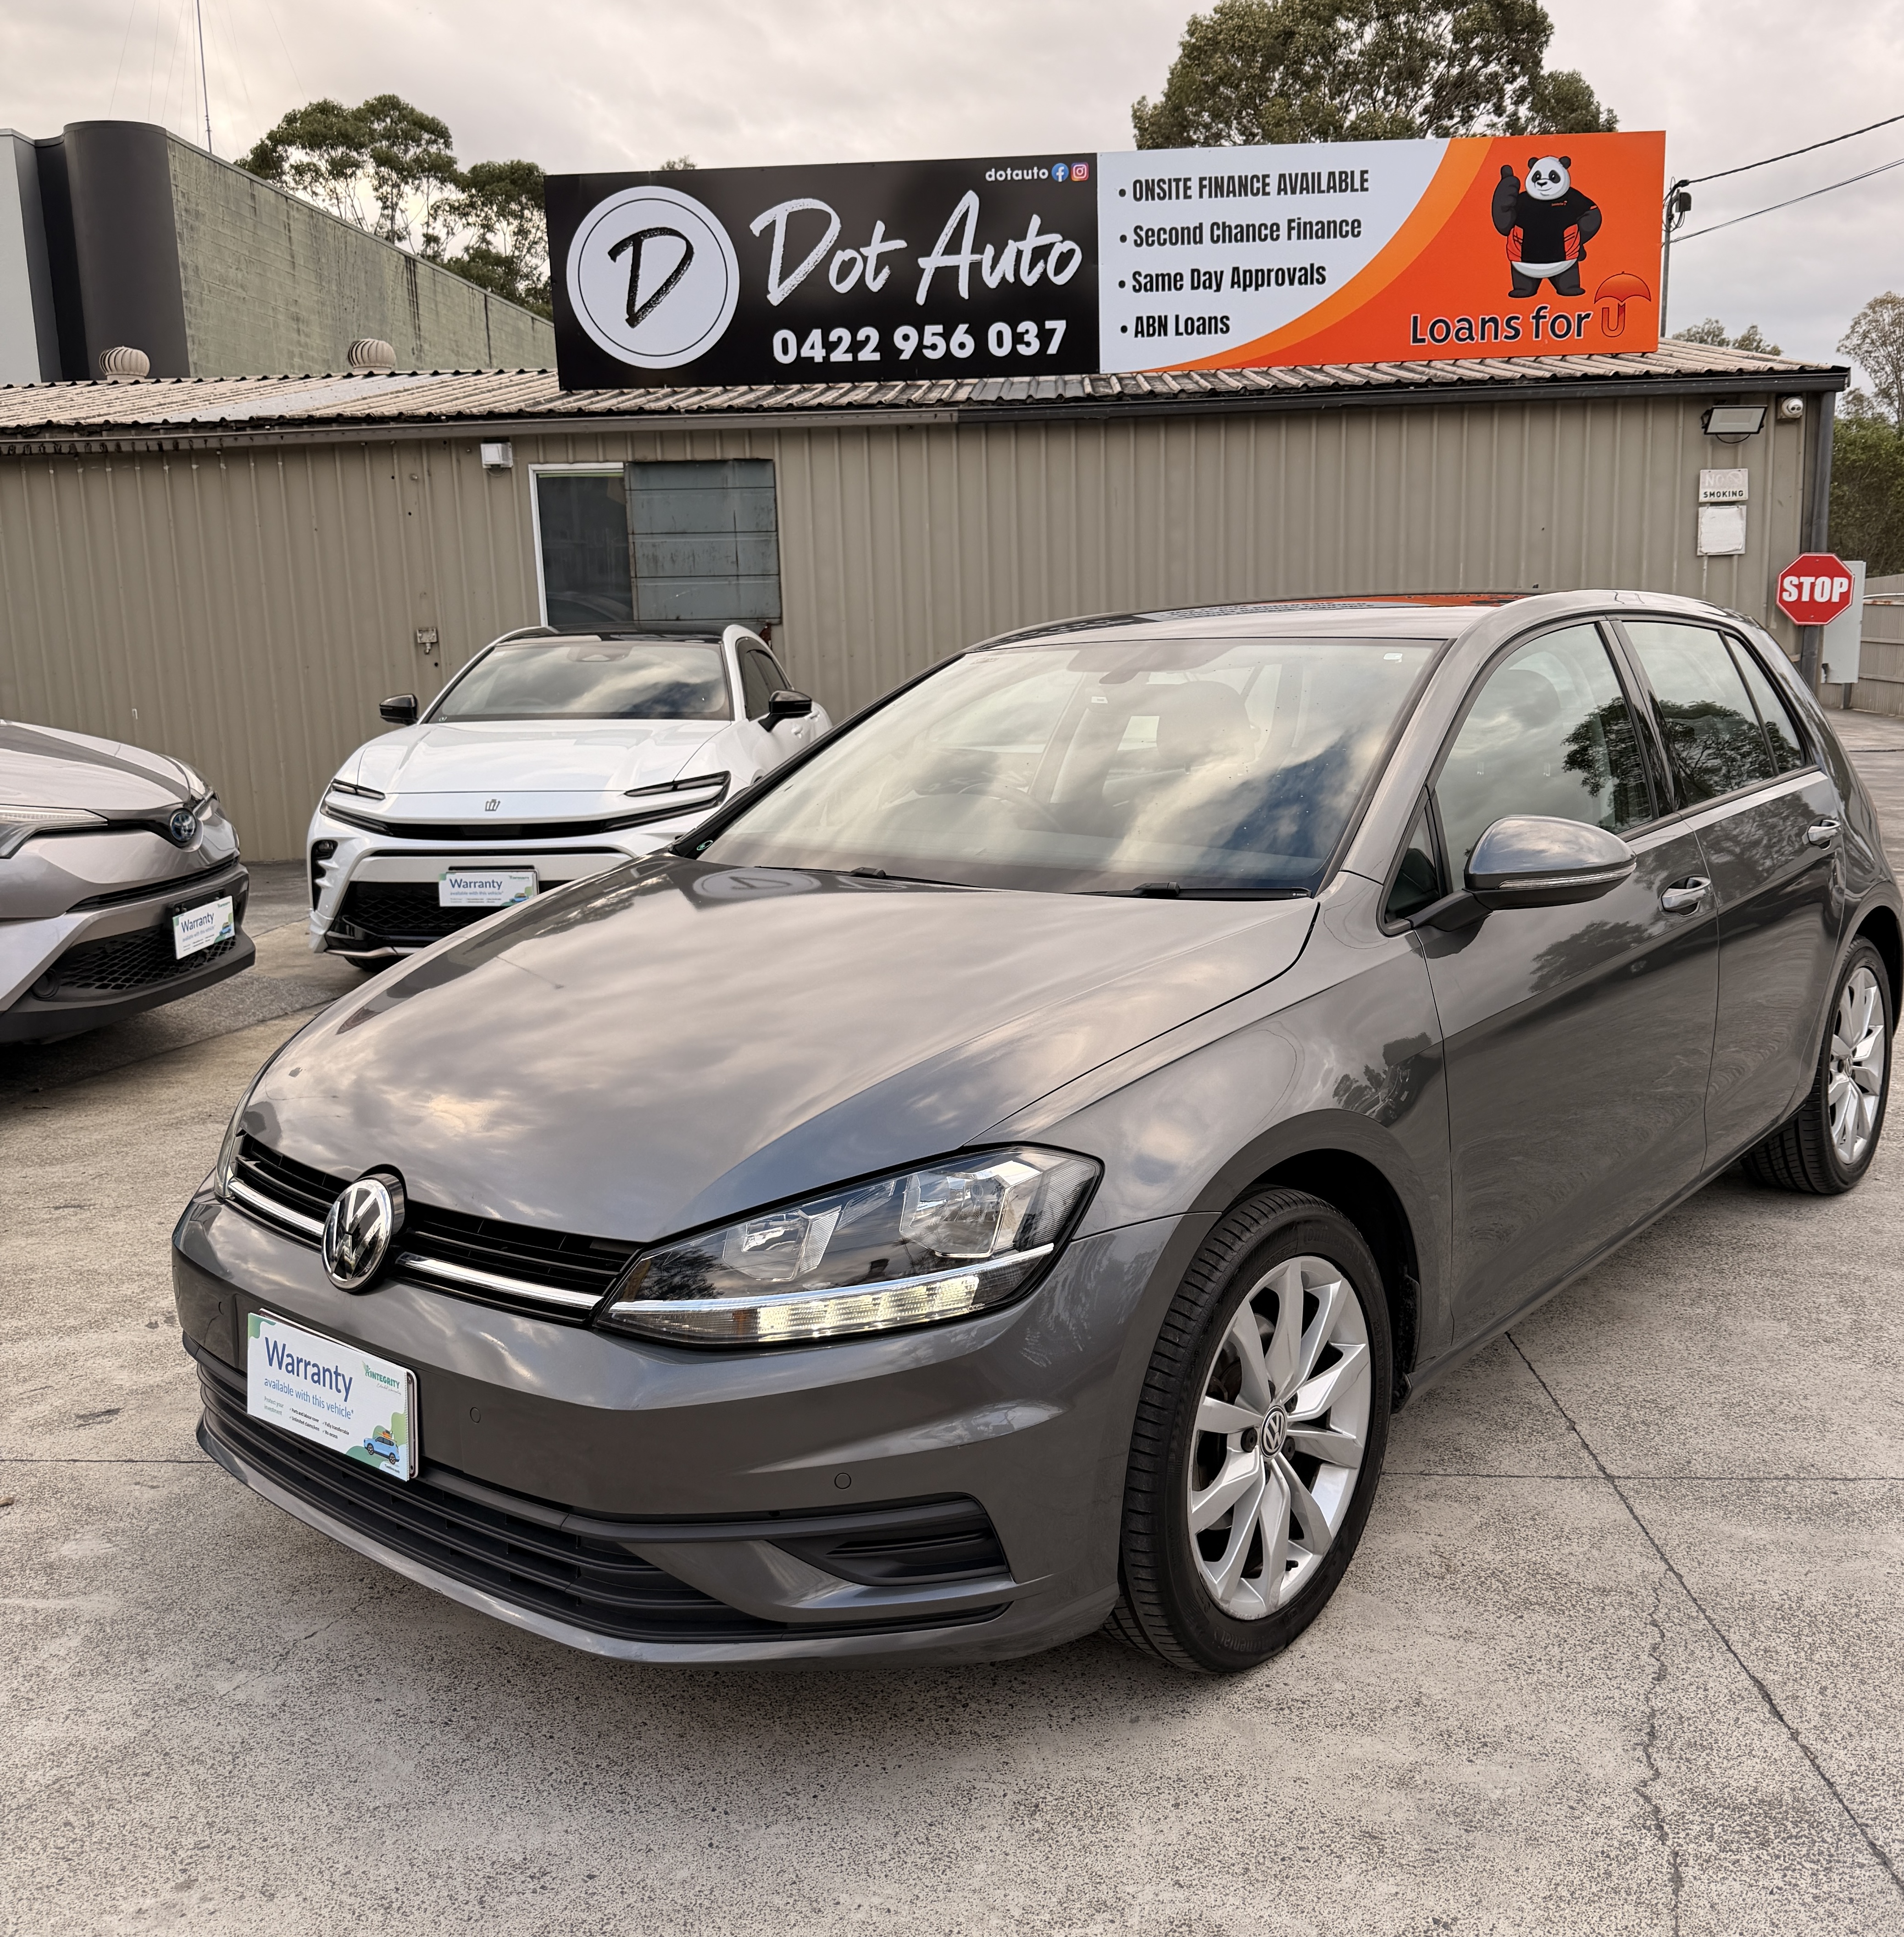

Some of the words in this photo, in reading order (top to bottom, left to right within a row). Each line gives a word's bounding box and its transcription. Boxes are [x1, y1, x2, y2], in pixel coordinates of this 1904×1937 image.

[985, 167, 1049, 182] dotauto
[1132, 177, 1192, 202] ONSITE
[1199, 174, 1271, 199] FINANCE
[1277, 170, 1369, 195] AVAILABLE
[749, 198, 907, 306] Dot
[916, 190, 1082, 305] Auto
[1133, 222, 1203, 248] Second
[1210, 221, 1280, 244] Chance
[1287, 217, 1361, 241] Finance
[607, 226, 694, 329] D
[1132, 271, 1184, 293] Same
[1190, 268, 1224, 293] Day
[1230, 263, 1326, 292] Approvals
[1134, 315, 1168, 338] ABN
[1175, 314, 1230, 336] Loans
[1411, 315, 1521, 344] Loans
[1532, 305, 1592, 339] for
[773, 327, 881, 364] 0422
[894, 324, 975, 360] 956
[988, 320, 1066, 357] 037
[1782, 576, 1849, 603] STOP
[450, 878, 503, 890] Warranty
[181, 912, 214, 933] Warranty
[265, 1337, 353, 1403] Warranty
[370, 1370, 400, 1389] INTEGRITY
[264, 1378, 294, 1396] available
[295, 1389, 311, 1403] with
[312, 1394, 325, 1409] this
